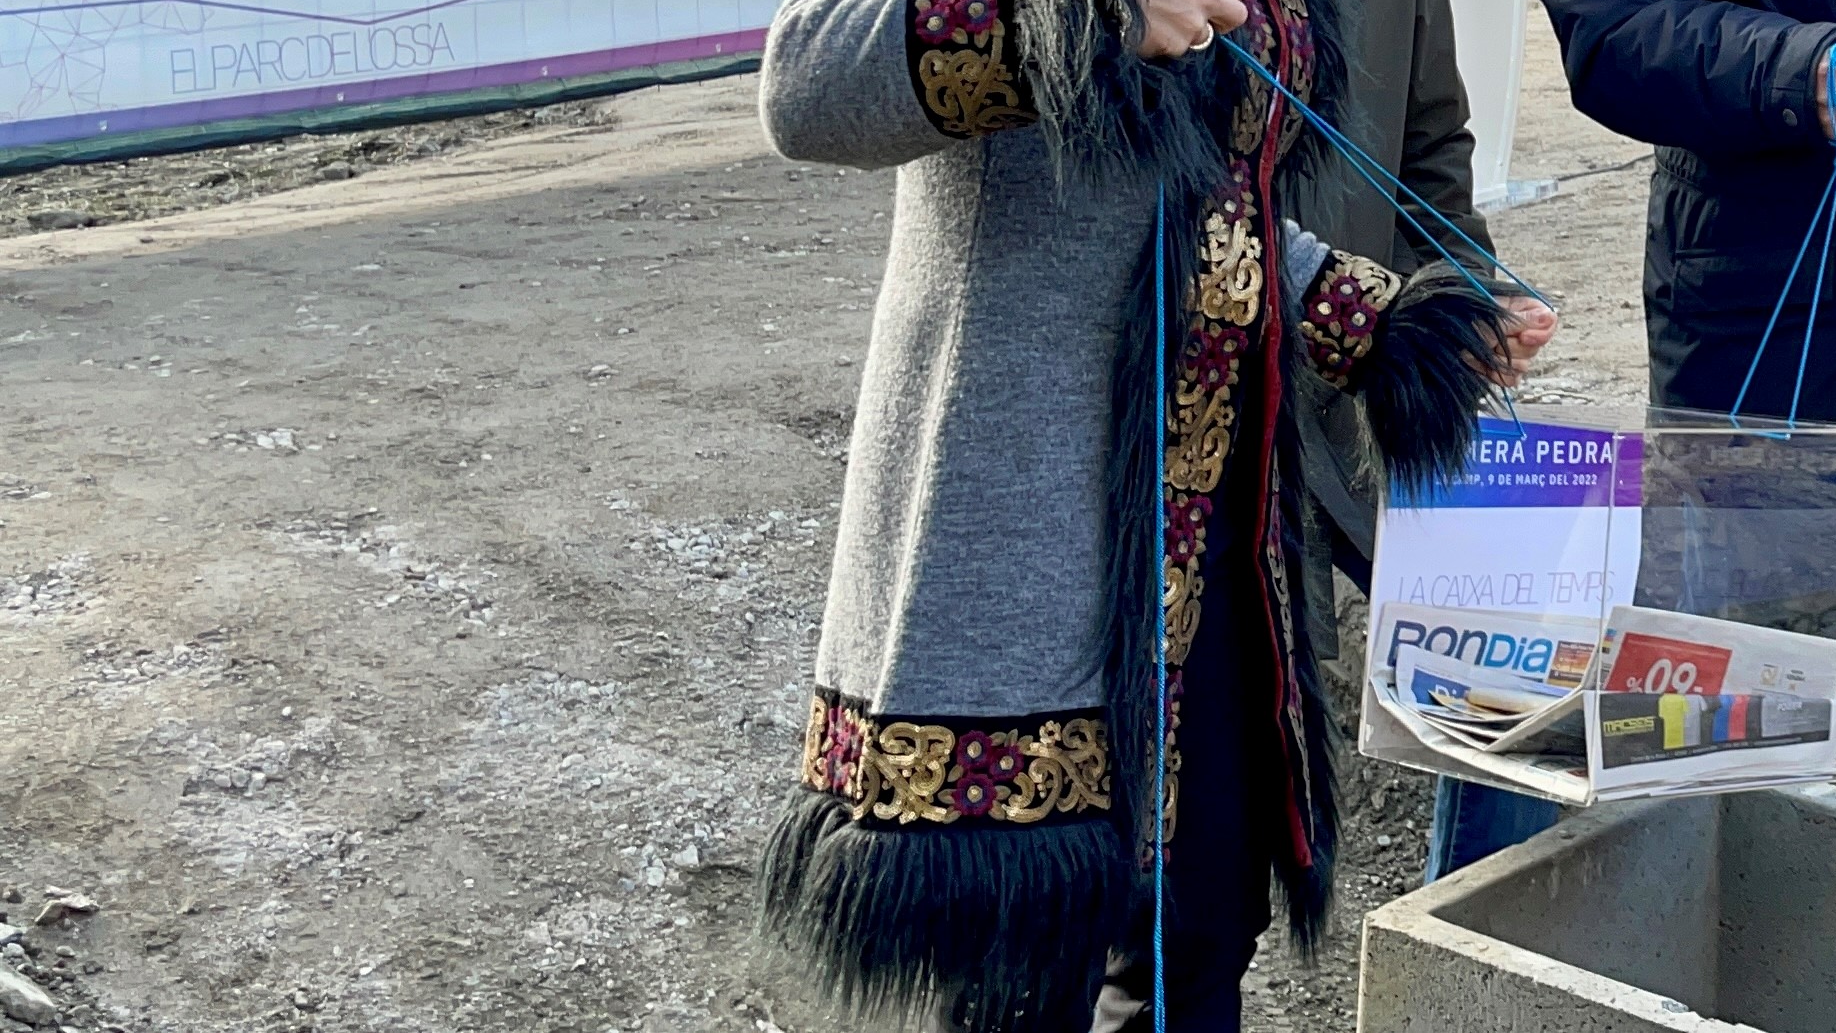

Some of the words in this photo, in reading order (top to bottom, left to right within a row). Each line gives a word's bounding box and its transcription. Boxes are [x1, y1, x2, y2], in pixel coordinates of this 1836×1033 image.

[1536, 440, 1613, 464] PEDRA
[1488, 474, 1495, 485] 9
[1498, 473, 1512, 486] DE
[1515, 473, 1545, 488] MARÇ
[1549, 473, 1569, 486] DEL
[1572, 473, 1598, 485] 2022
